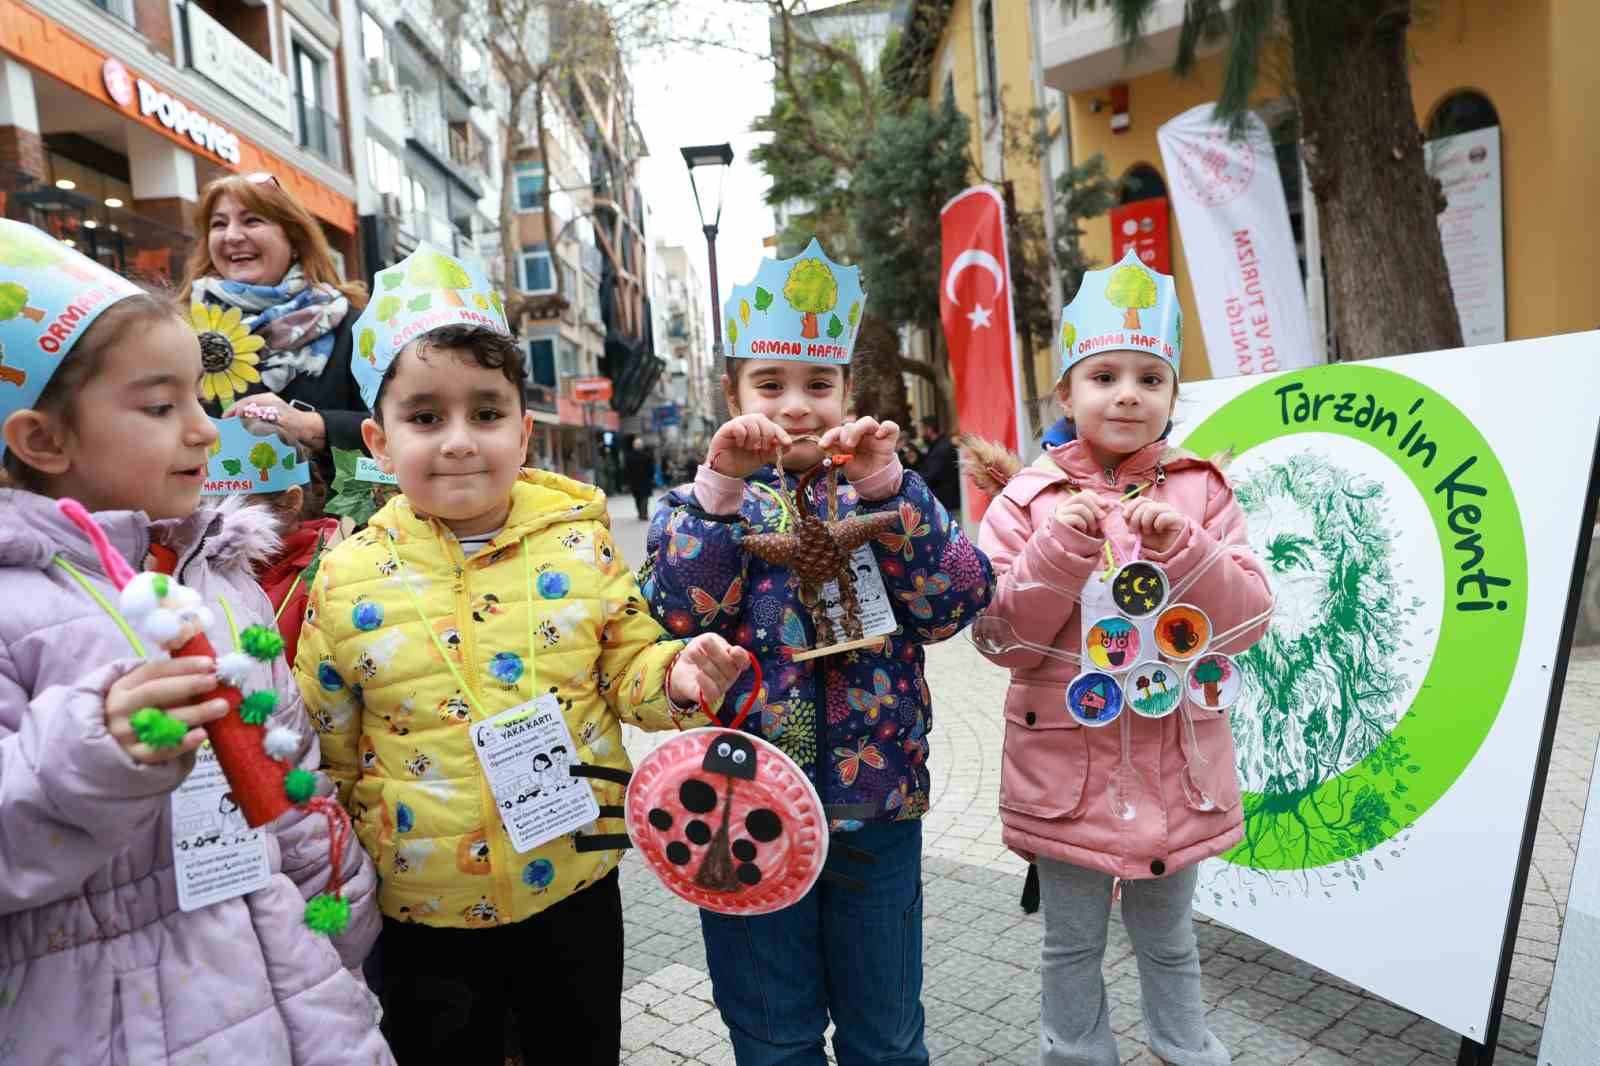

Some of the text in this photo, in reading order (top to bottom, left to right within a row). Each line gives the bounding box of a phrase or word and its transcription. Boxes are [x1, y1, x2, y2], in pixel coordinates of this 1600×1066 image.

[750, 340, 802, 356] ORMAN
[1078, 333, 1125, 353] ORMAN
[203, 479, 253, 492] HAFTASI
[1434, 455, 1512, 612] Kenti
[500, 726, 527, 741] YAKA
[526, 713, 553, 732] KARTI
